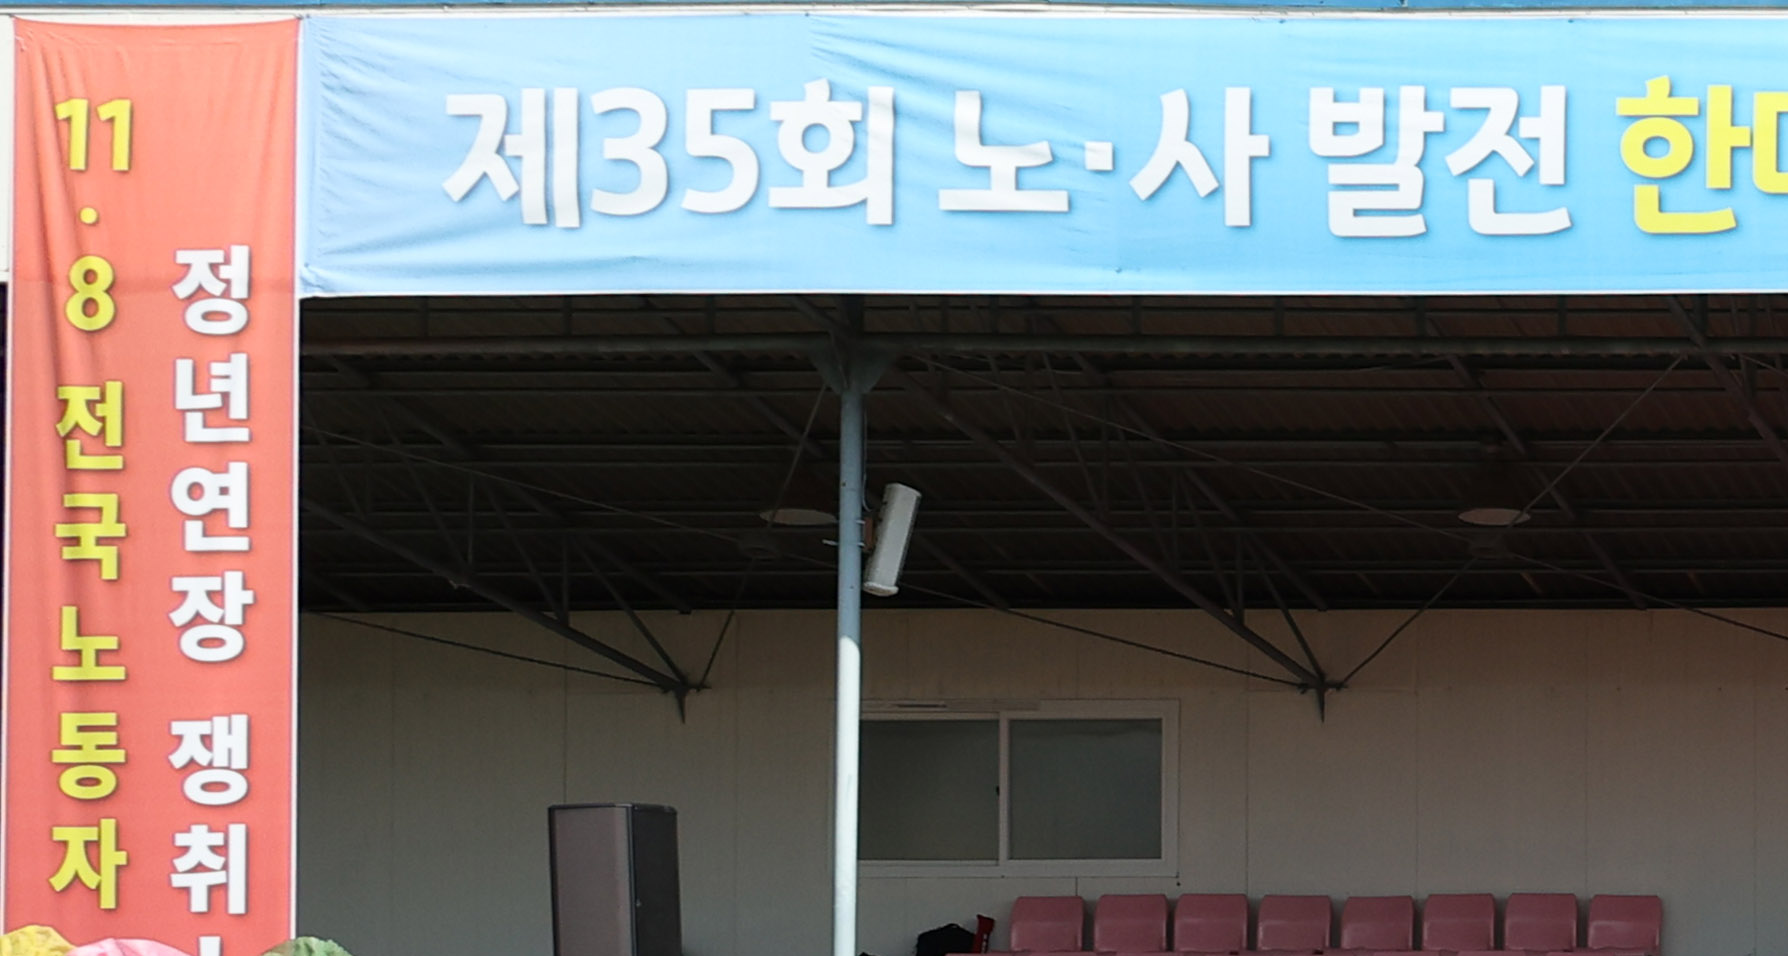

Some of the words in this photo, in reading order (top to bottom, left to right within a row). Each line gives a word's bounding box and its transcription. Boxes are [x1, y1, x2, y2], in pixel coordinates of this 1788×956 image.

[442, 77, 896, 229] 제35회
[937, 87, 1271, 229] 노·사
[1308, 85, 1572, 239] 발전
[169, 244, 254, 663] 정년연장
